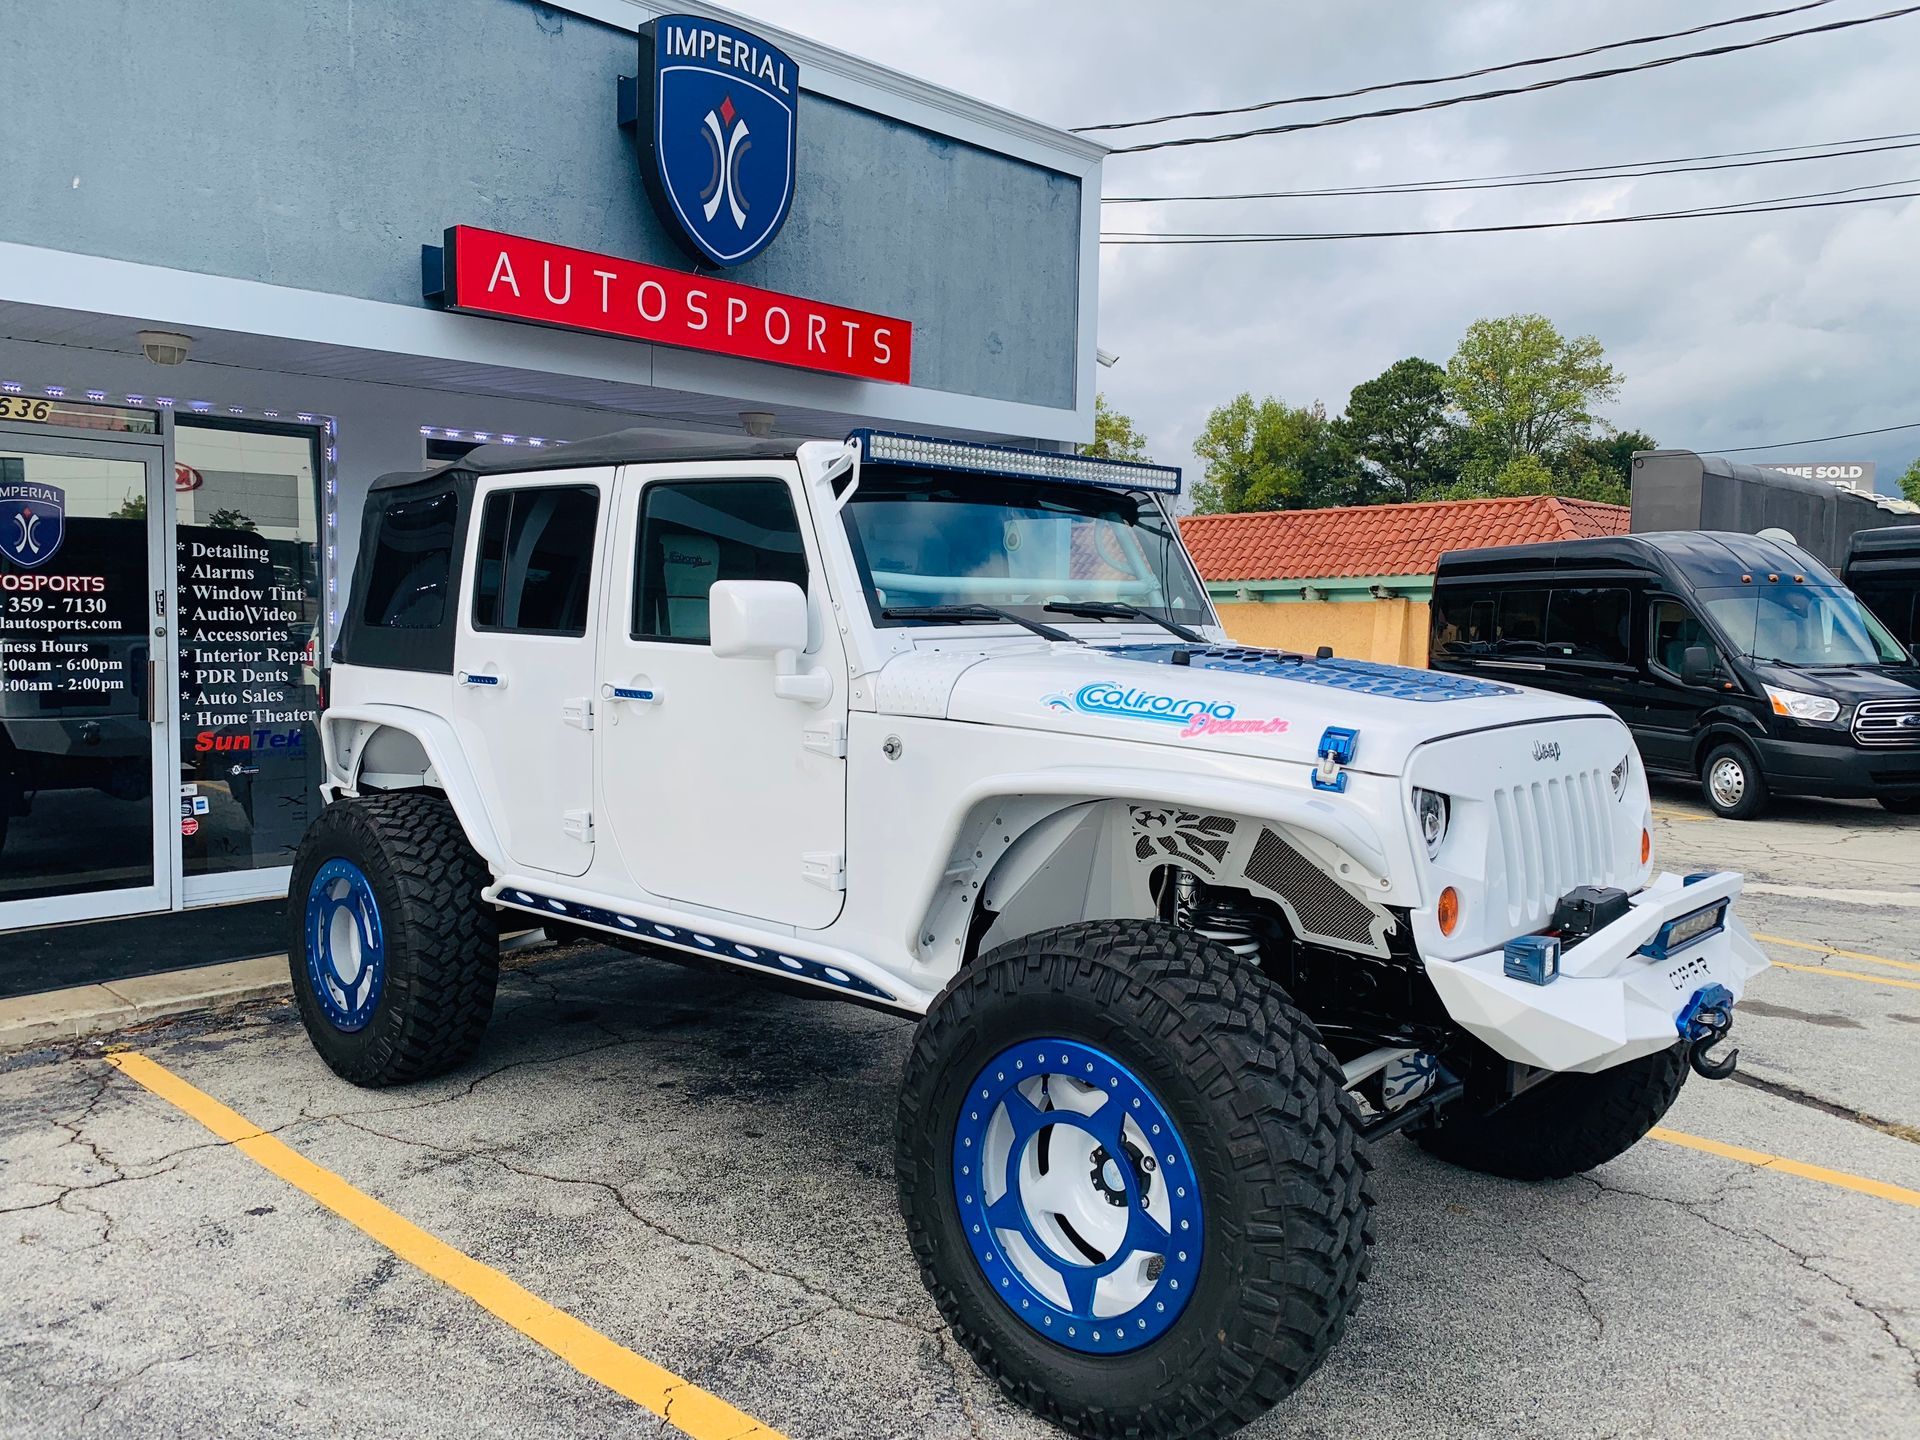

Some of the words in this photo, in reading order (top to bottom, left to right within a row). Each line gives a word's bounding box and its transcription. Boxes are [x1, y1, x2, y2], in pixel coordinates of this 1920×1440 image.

[666, 26, 790, 94] IMPERIAL
[487, 251, 892, 364] AUTOSPORTS
[1815, 466, 1863, 479] SOLD
[191, 542, 270, 564] Detailing
[191, 564, 255, 580] Alarms
[0, 575, 105, 592] OSPORTS
[192, 585, 264, 600] Window
[268, 586, 304, 601] Tint
[8, 597, 44, 613] 359
[62, 597, 107, 613] 7130
[192, 604, 297, 624] Audio\Video
[193, 627, 288, 642] Accessories
[41, 640, 89, 653] Hours
[194, 648, 262, 663] Interior
[66, 658, 123, 673] 6:00pm
[195, 669, 237, 684] PDR
[241, 668, 289, 683] Dents
[68, 678, 124, 693] 2:00pm
[195, 691, 237, 705] Auto
[242, 688, 284, 704] Sales
[1076, 681, 1236, 724] California
[197, 711, 248, 726] Home
[252, 708, 316, 724] Theater
[1532, 739, 1560, 761] Jeep
